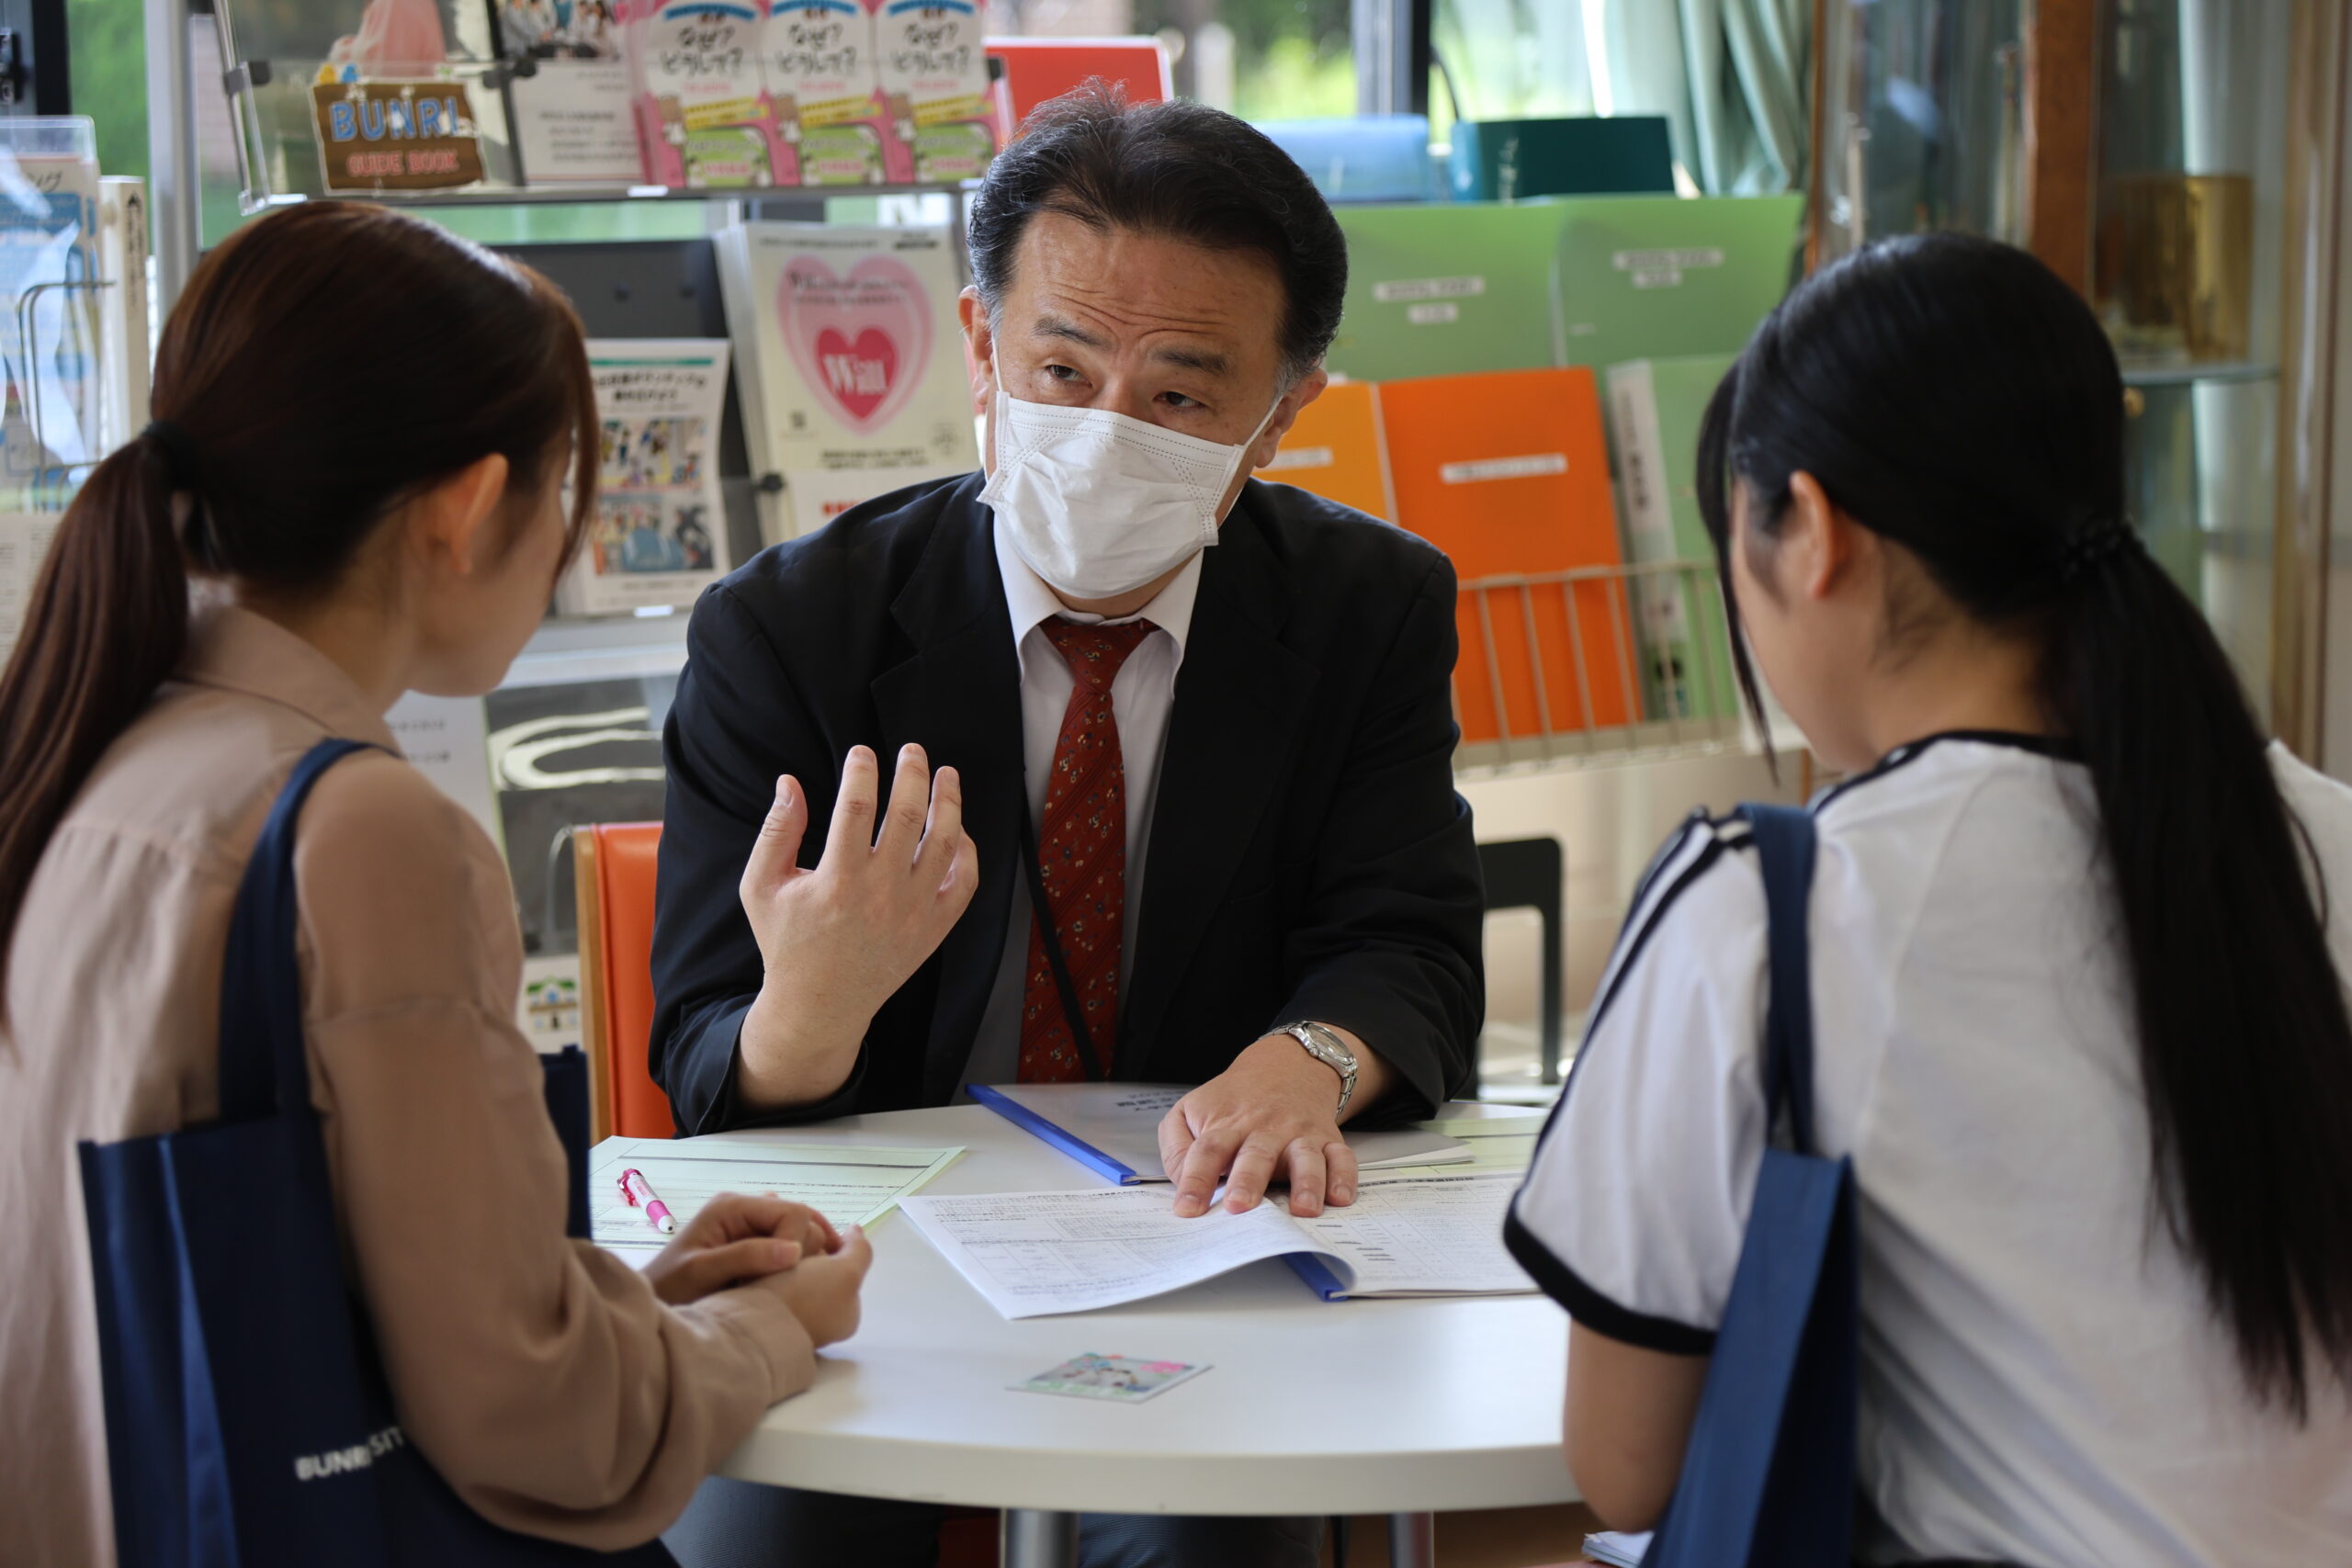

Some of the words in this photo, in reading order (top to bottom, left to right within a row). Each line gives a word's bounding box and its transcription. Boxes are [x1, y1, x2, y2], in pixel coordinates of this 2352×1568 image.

[328, 95, 459, 142] BUNRI
[347, 151, 403, 177] GUIDE
[407, 149, 458, 175] BOOK
